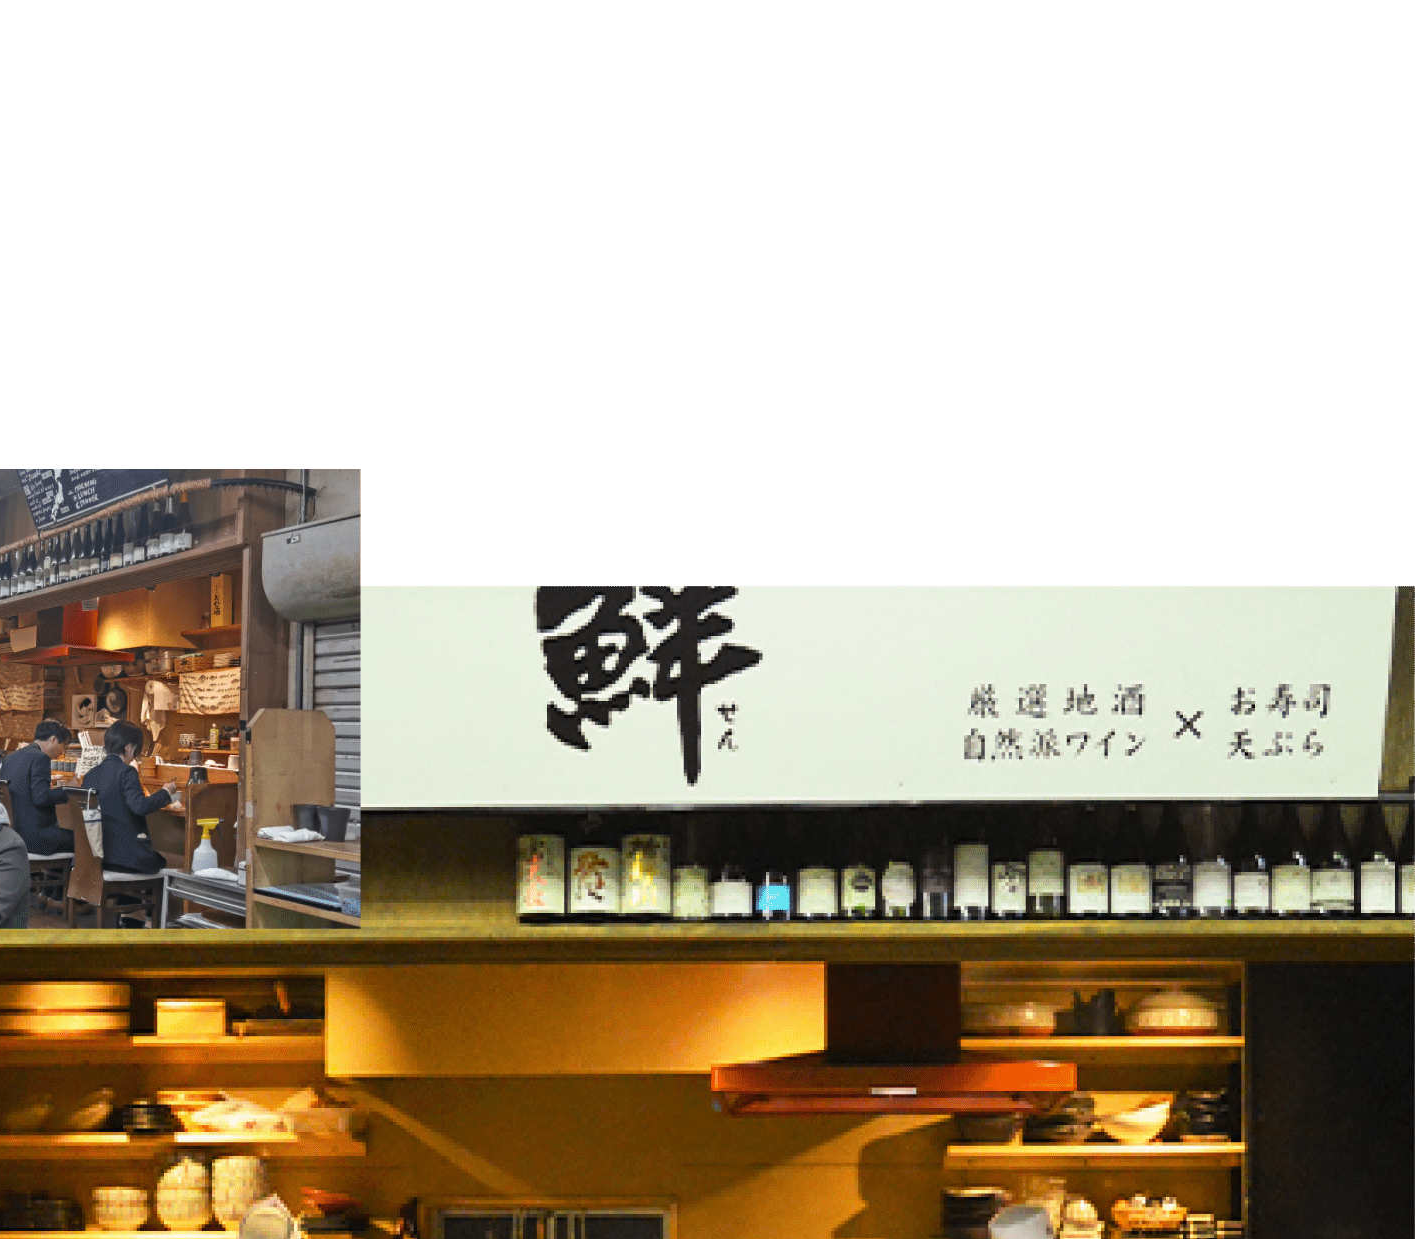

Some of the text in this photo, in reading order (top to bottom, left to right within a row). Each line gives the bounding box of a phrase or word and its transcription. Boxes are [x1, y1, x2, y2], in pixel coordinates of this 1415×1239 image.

[78, 487, 95, 500] LUNCH
[1230, 682, 1331, 719] お寿司
[963, 727, 1147, 762] 自然派ワイン
[1227, 728, 1326, 761] 天ぷら
